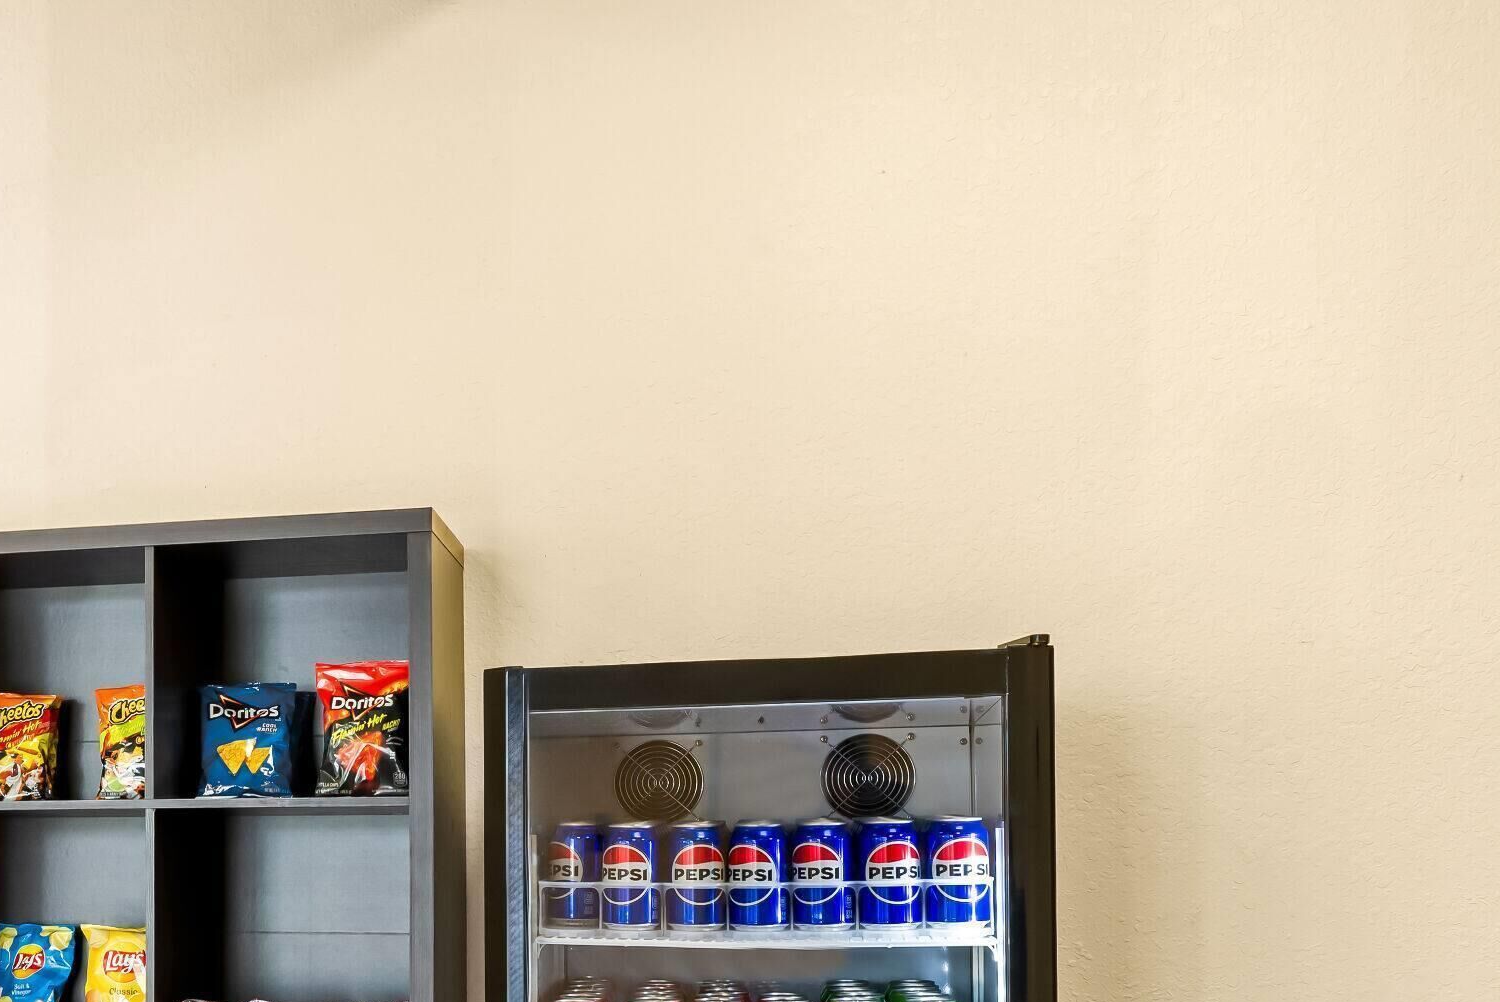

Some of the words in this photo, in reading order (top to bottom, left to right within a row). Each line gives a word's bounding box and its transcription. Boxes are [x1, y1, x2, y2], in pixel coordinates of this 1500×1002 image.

[331, 694, 394, 710] Doritos
[109, 697, 145, 724] Chee
[209, 703, 280, 720] Doritos
[367, 713, 388, 728] Hot
[551, 864, 579, 877] PSI
[602, 867, 648, 881] PEPSI
[674, 868, 724, 881] PEPSI
[728, 868, 773, 882] PEPSI
[791, 866, 840, 880] PEPSI
[868, 865, 921, 880] PEPSI
[935, 863, 989, 878] PEPSI
[109, 987, 139, 996] Classic
